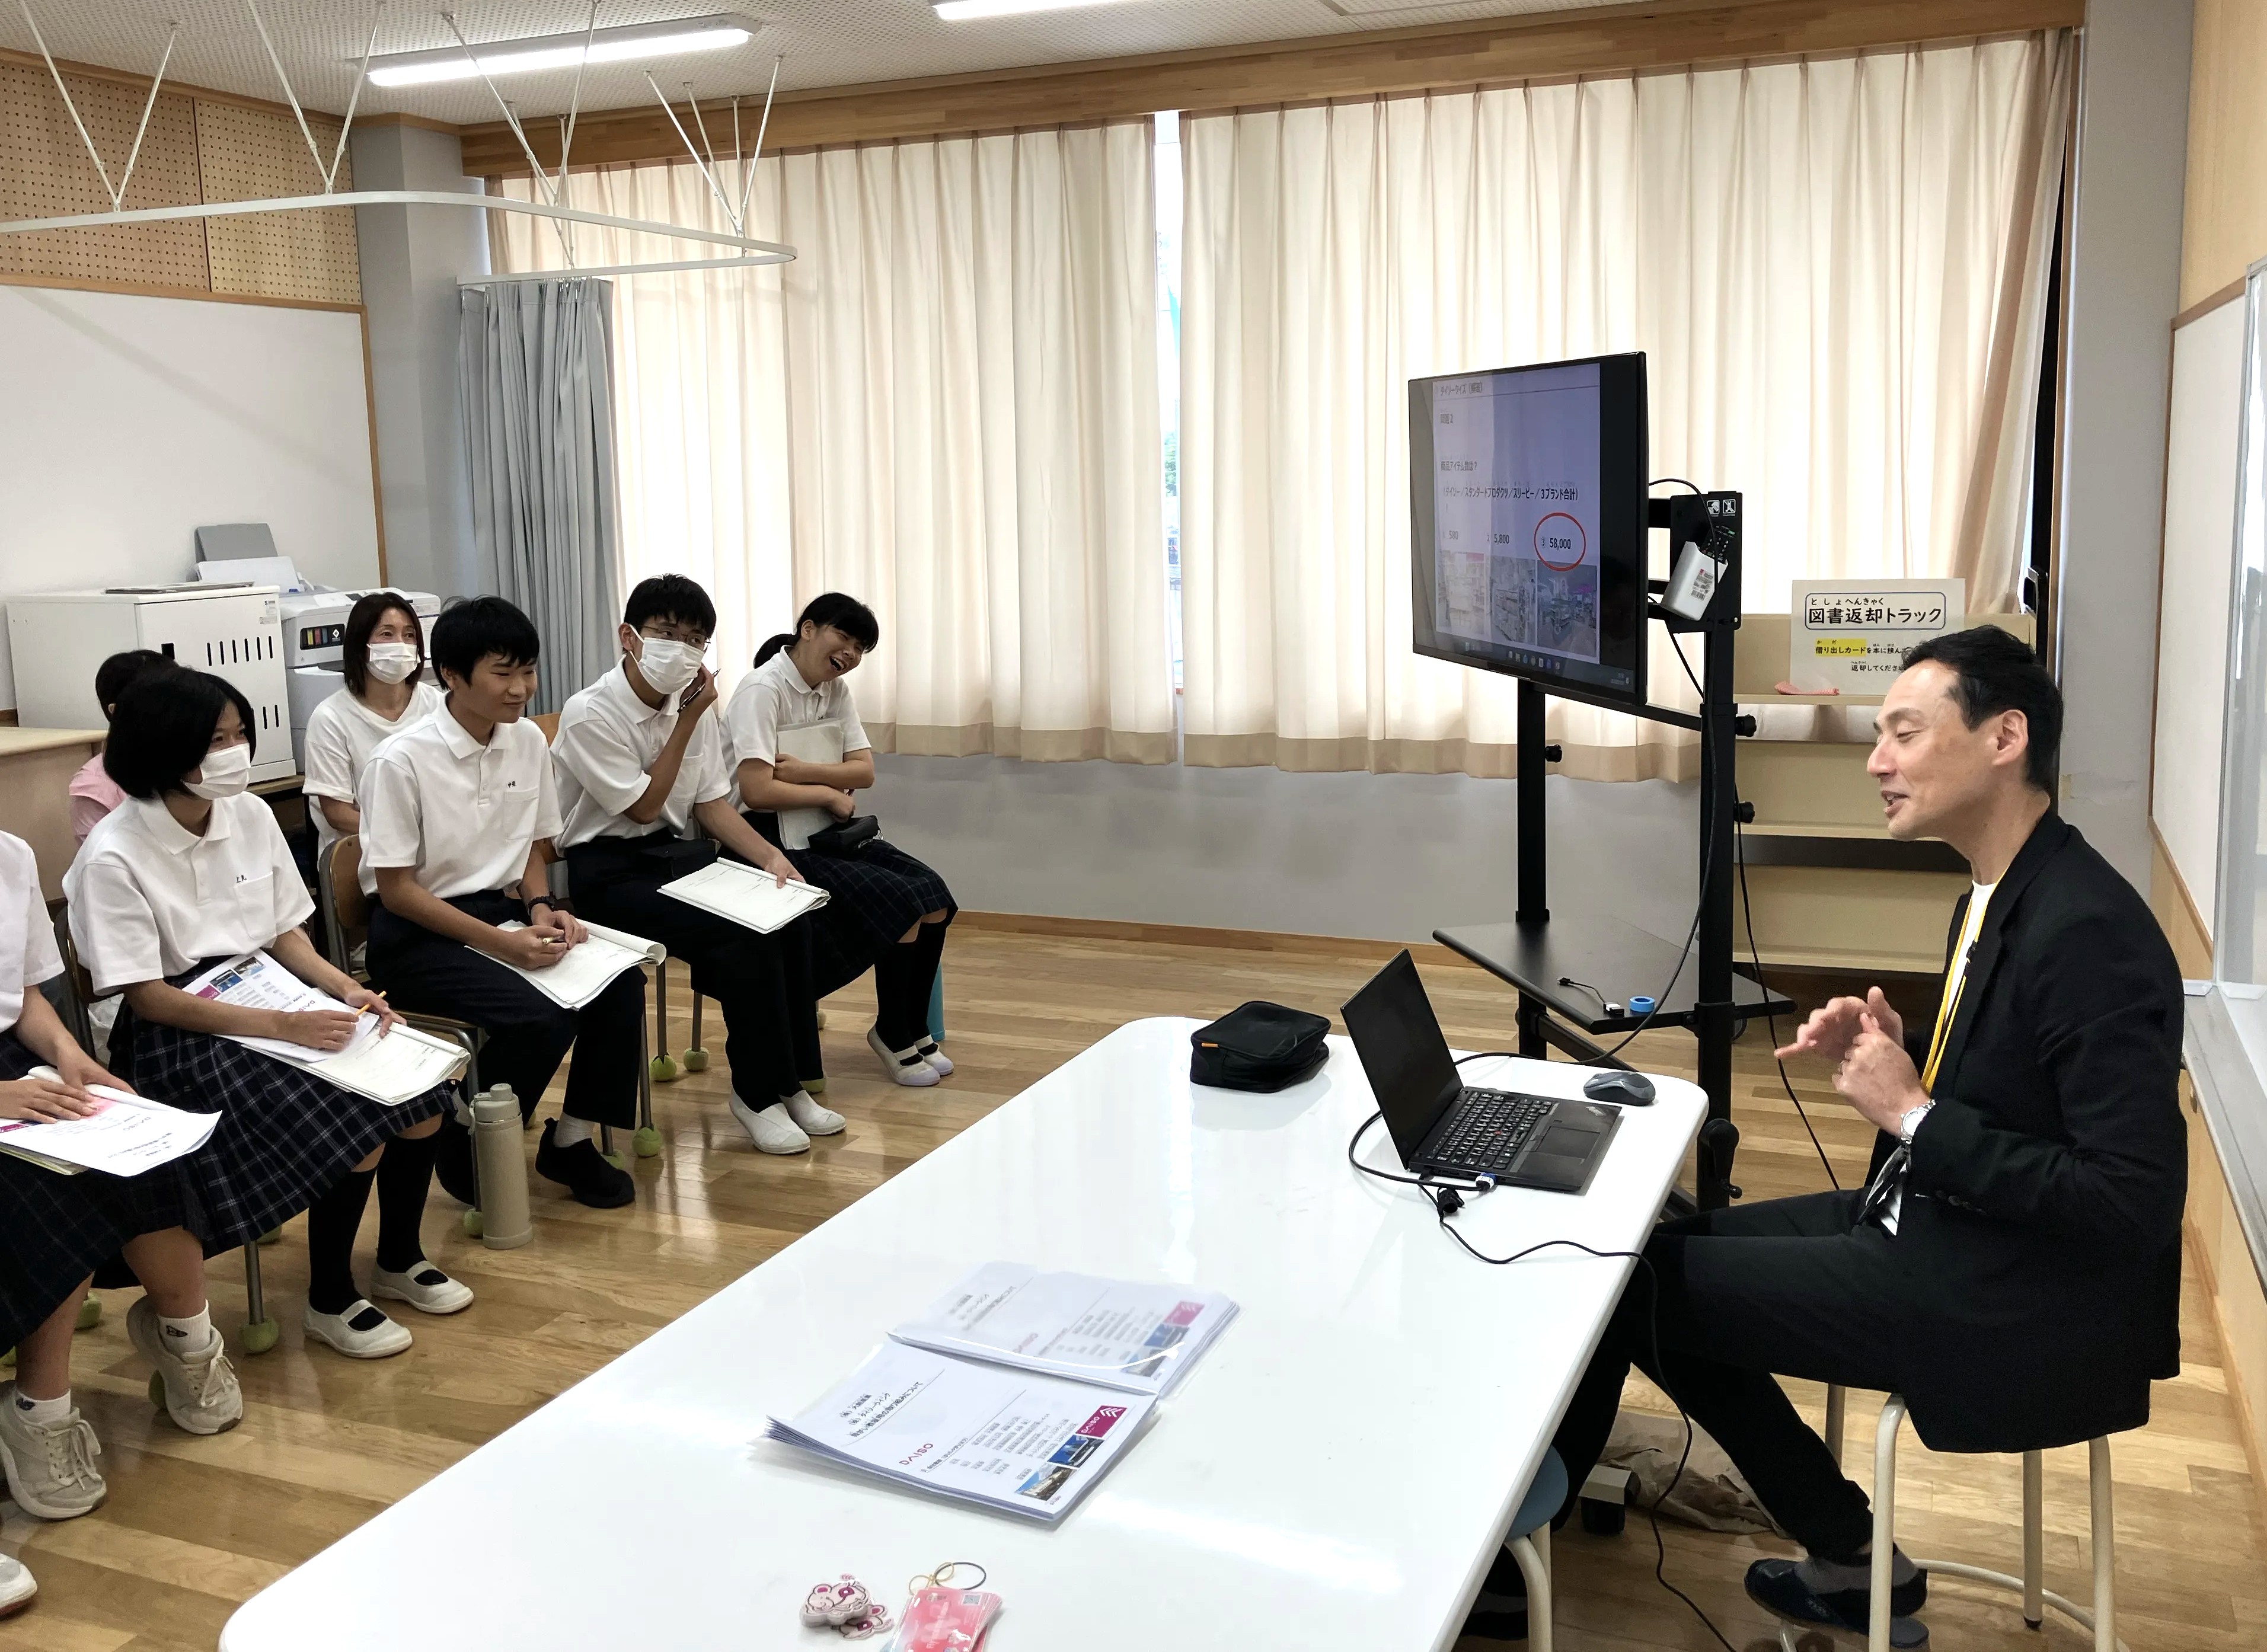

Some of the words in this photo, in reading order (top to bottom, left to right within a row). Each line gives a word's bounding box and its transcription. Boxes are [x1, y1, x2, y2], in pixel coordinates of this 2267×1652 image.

[1494, 534, 1510, 545] 5,800
[1550, 538, 1571, 550] 58,000
[1809, 608, 1942, 624] 図書返却トラック
[899, 1443, 934, 1465] DAISO
